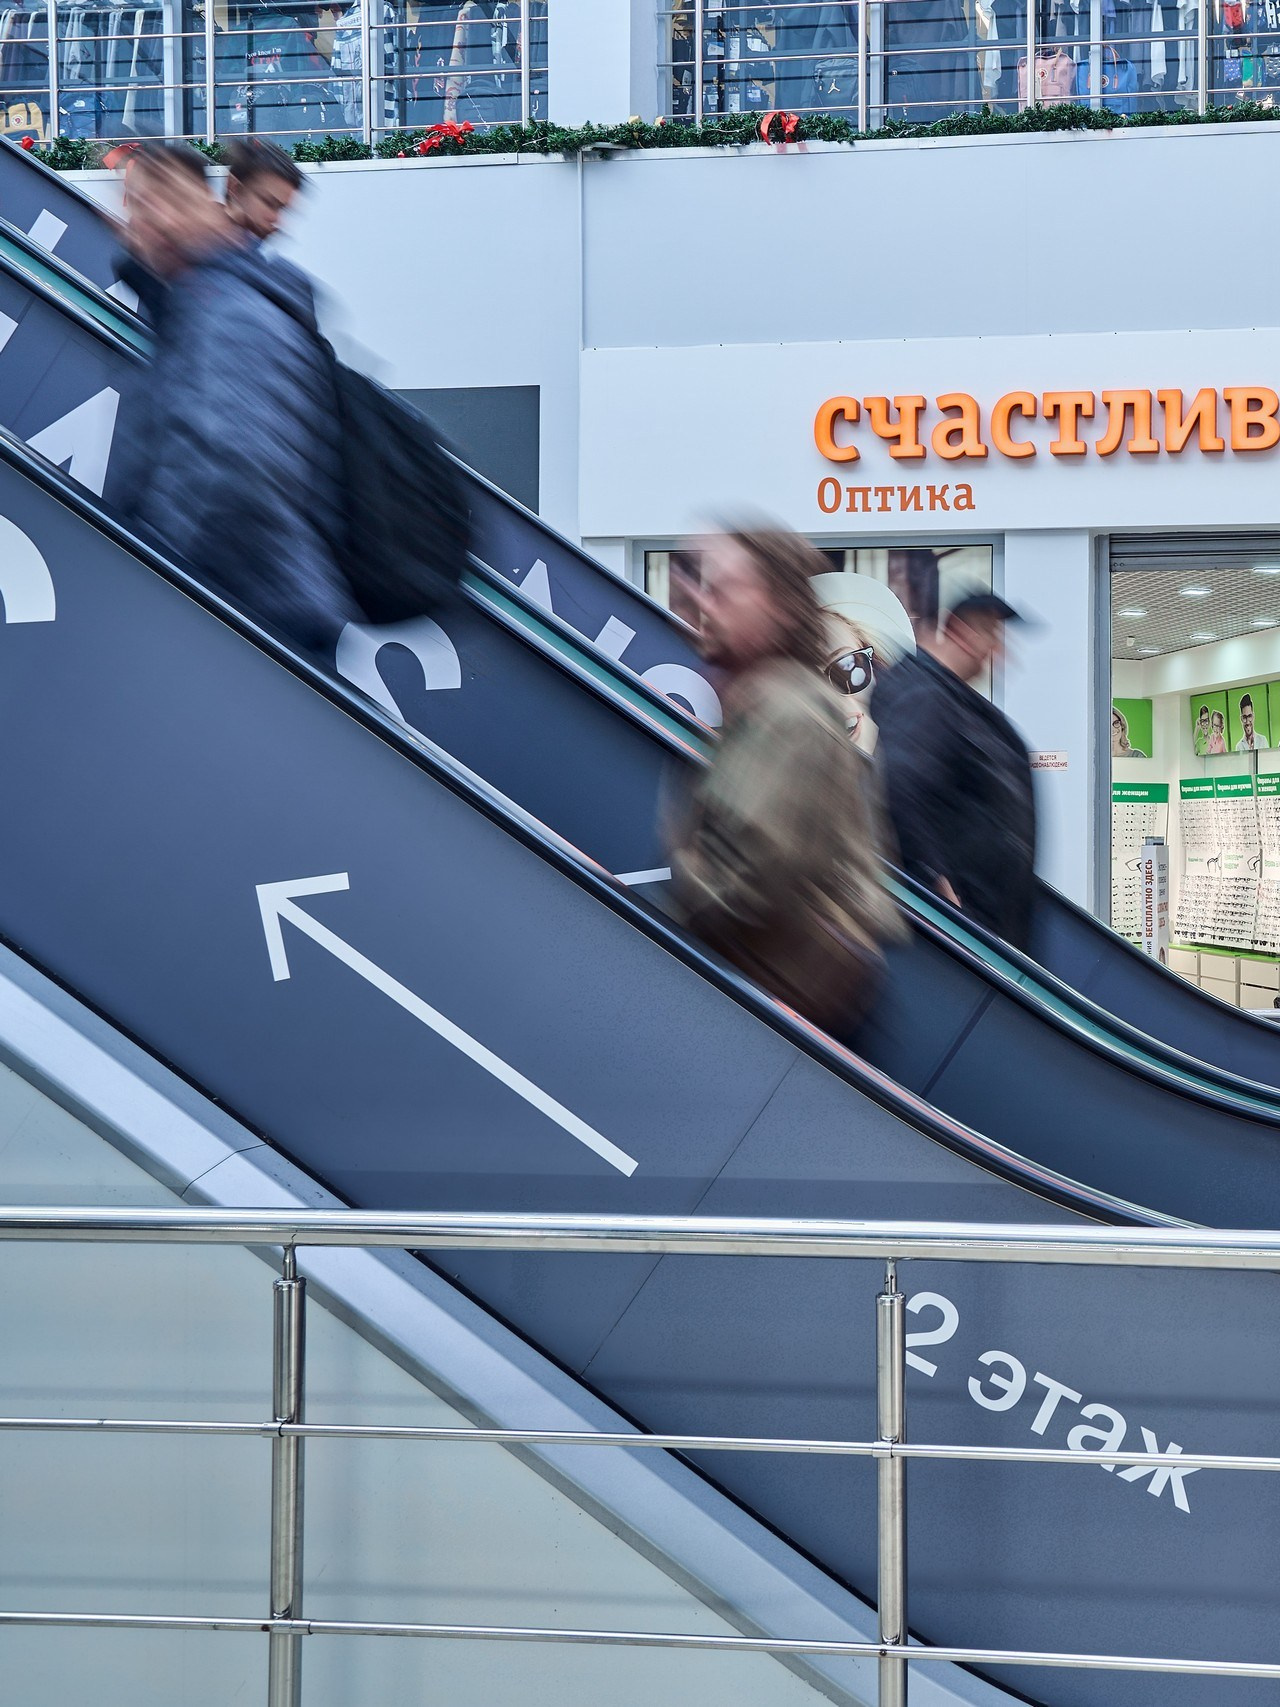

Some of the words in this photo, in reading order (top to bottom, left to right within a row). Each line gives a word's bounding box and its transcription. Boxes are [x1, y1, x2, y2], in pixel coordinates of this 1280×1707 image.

[816, 476, 976, 514] Оптика
[1145, 859, 1155, 886] ЗДЕСЬ
[1145, 887, 1154, 938] БЕСПЛАТНО
[905, 1291, 960, 1378] 2
[967, 1350, 1202, 1514] этаж
